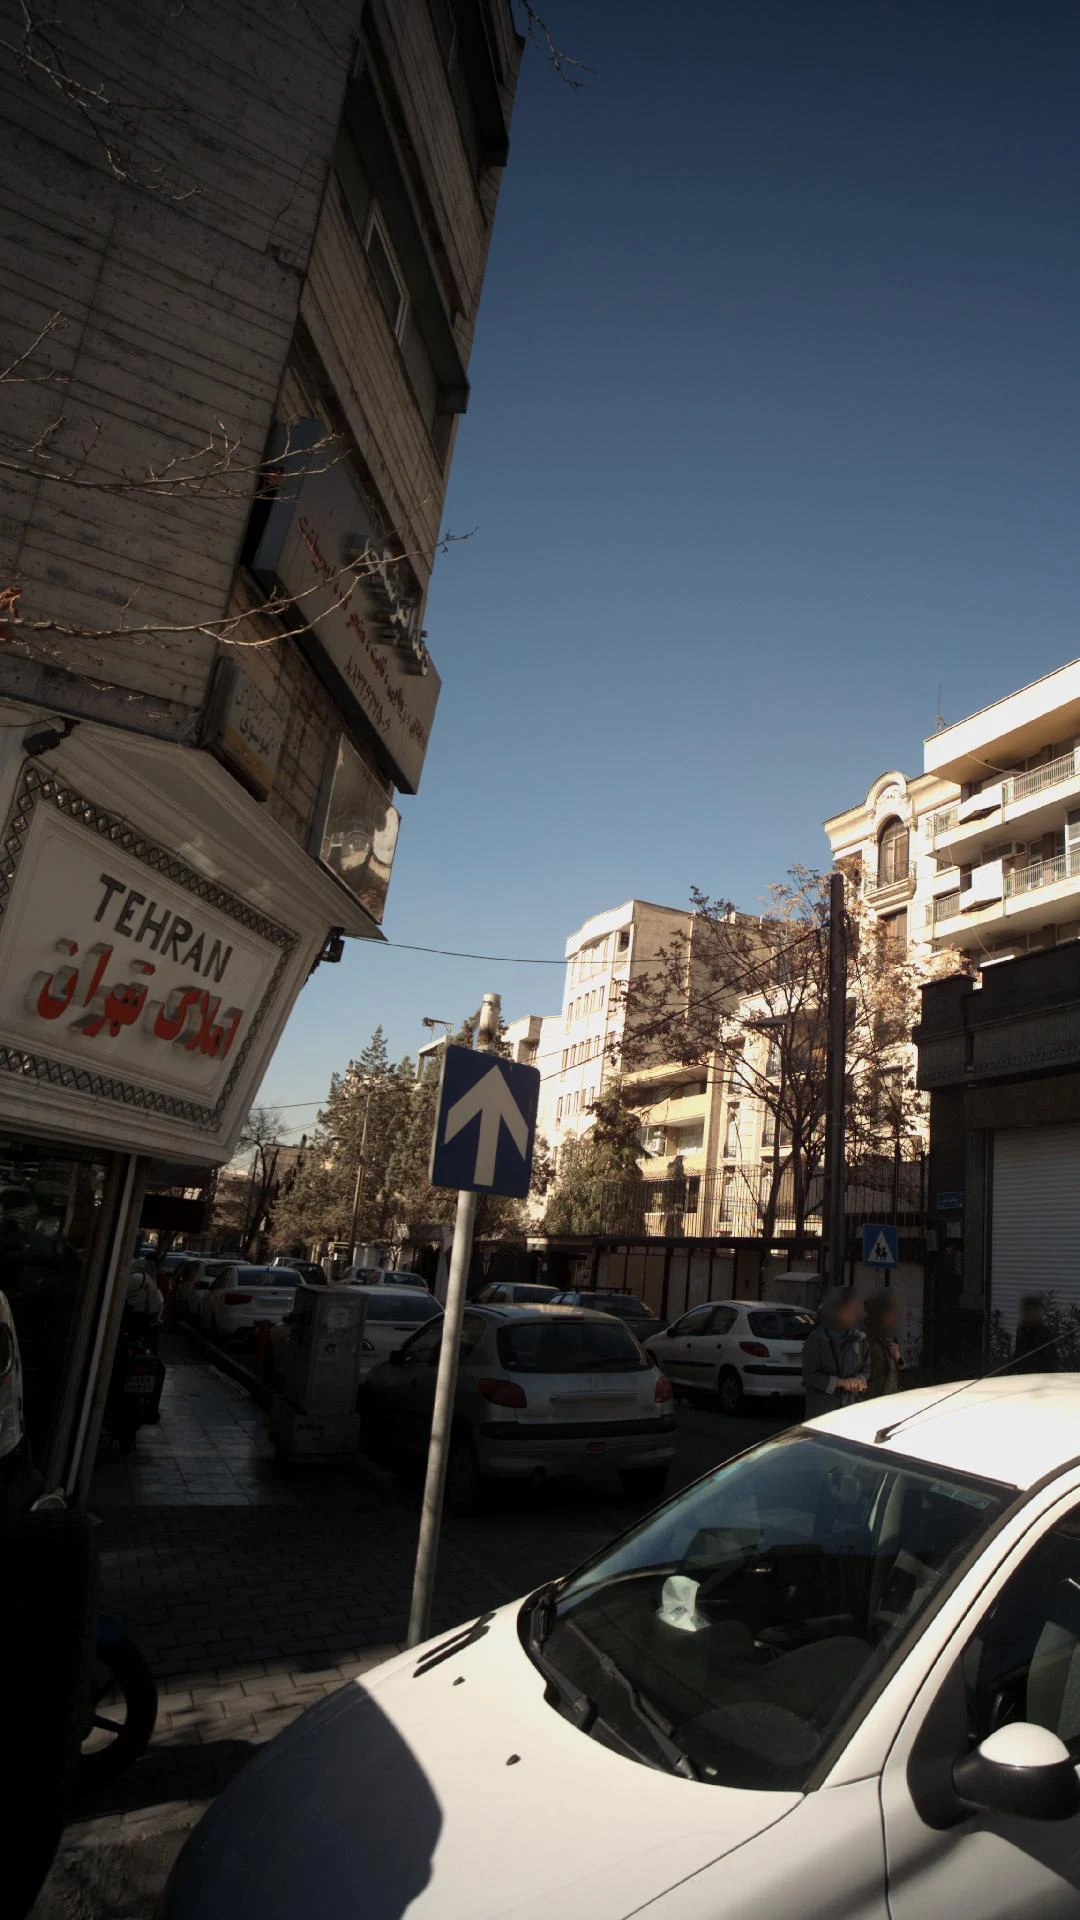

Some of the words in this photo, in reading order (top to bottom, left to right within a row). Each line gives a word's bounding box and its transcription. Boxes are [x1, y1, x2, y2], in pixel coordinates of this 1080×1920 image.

[94, 873, 233, 983] TEHRAN
[27, 938, 157, 1038] تهران
[144, 985, 243, 1062] املاک
